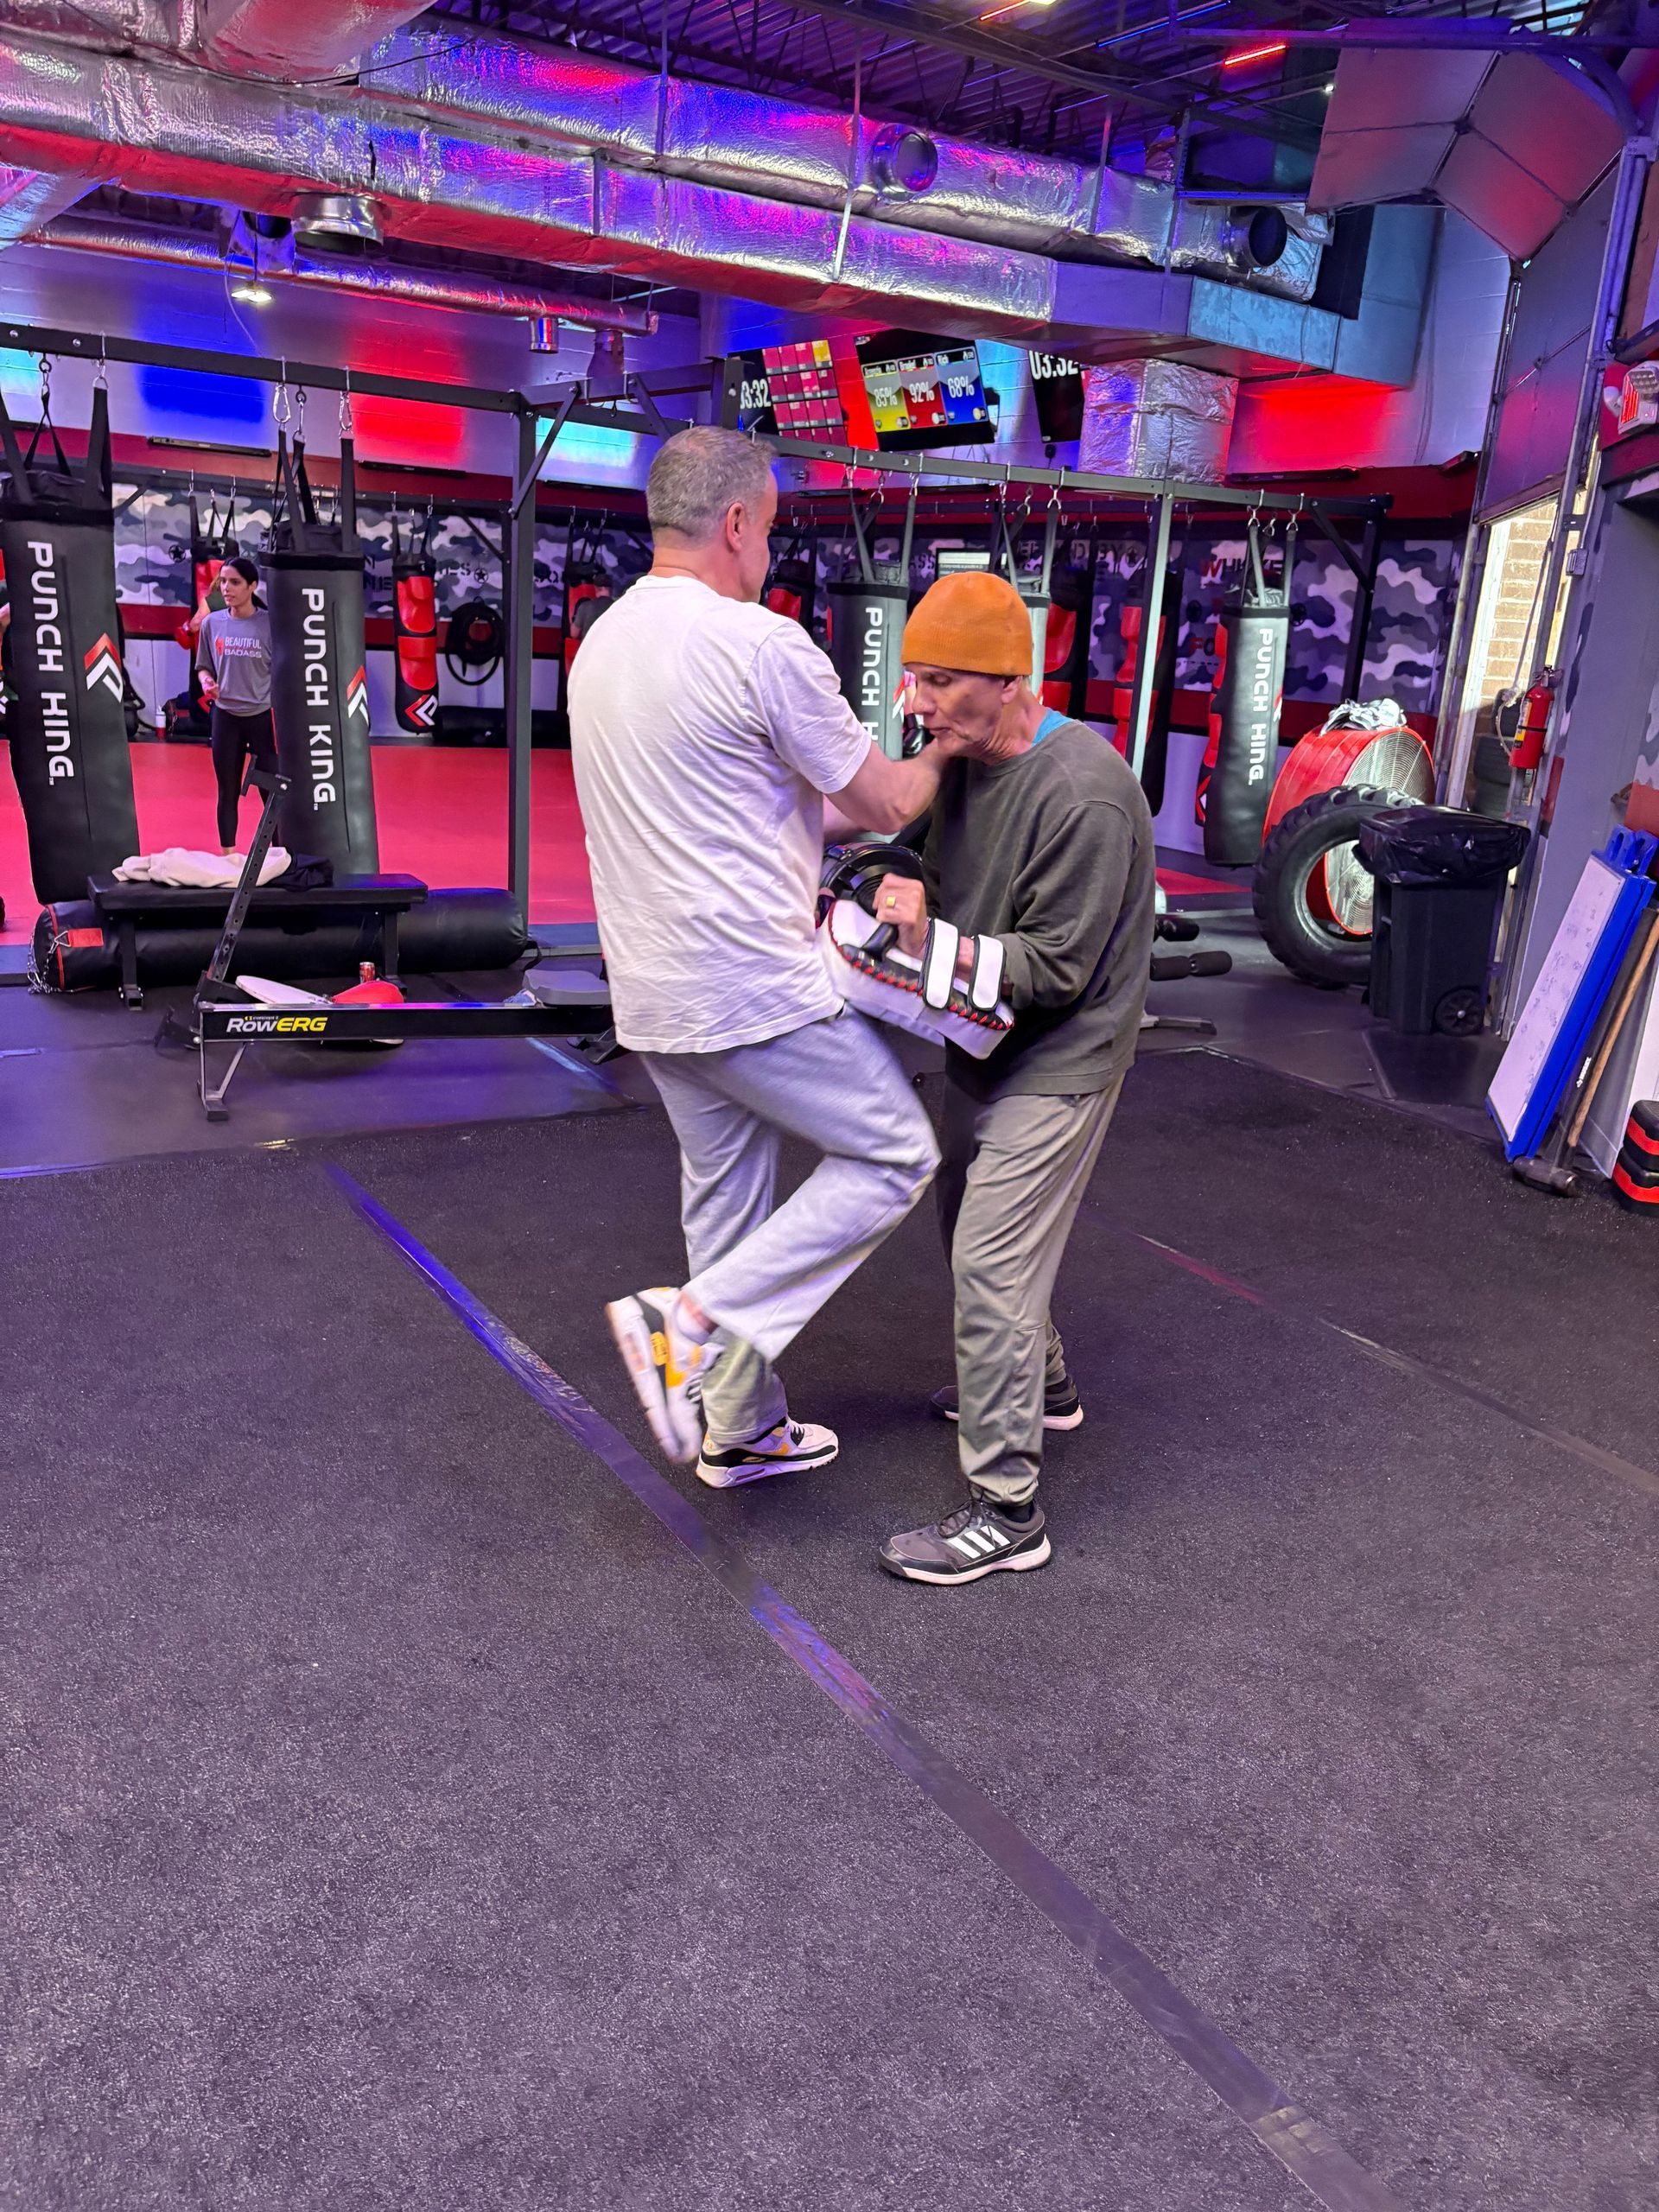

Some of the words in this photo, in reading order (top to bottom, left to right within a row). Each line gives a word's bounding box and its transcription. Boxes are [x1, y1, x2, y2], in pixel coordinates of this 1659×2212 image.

[874, 386, 898, 408] 85%
[909, 382, 935, 404] 92%
[947, 376, 975, 398] 68%
[225, 636, 262, 649] BEAUTIFUL
[225, 648, 262, 658] BADASS
